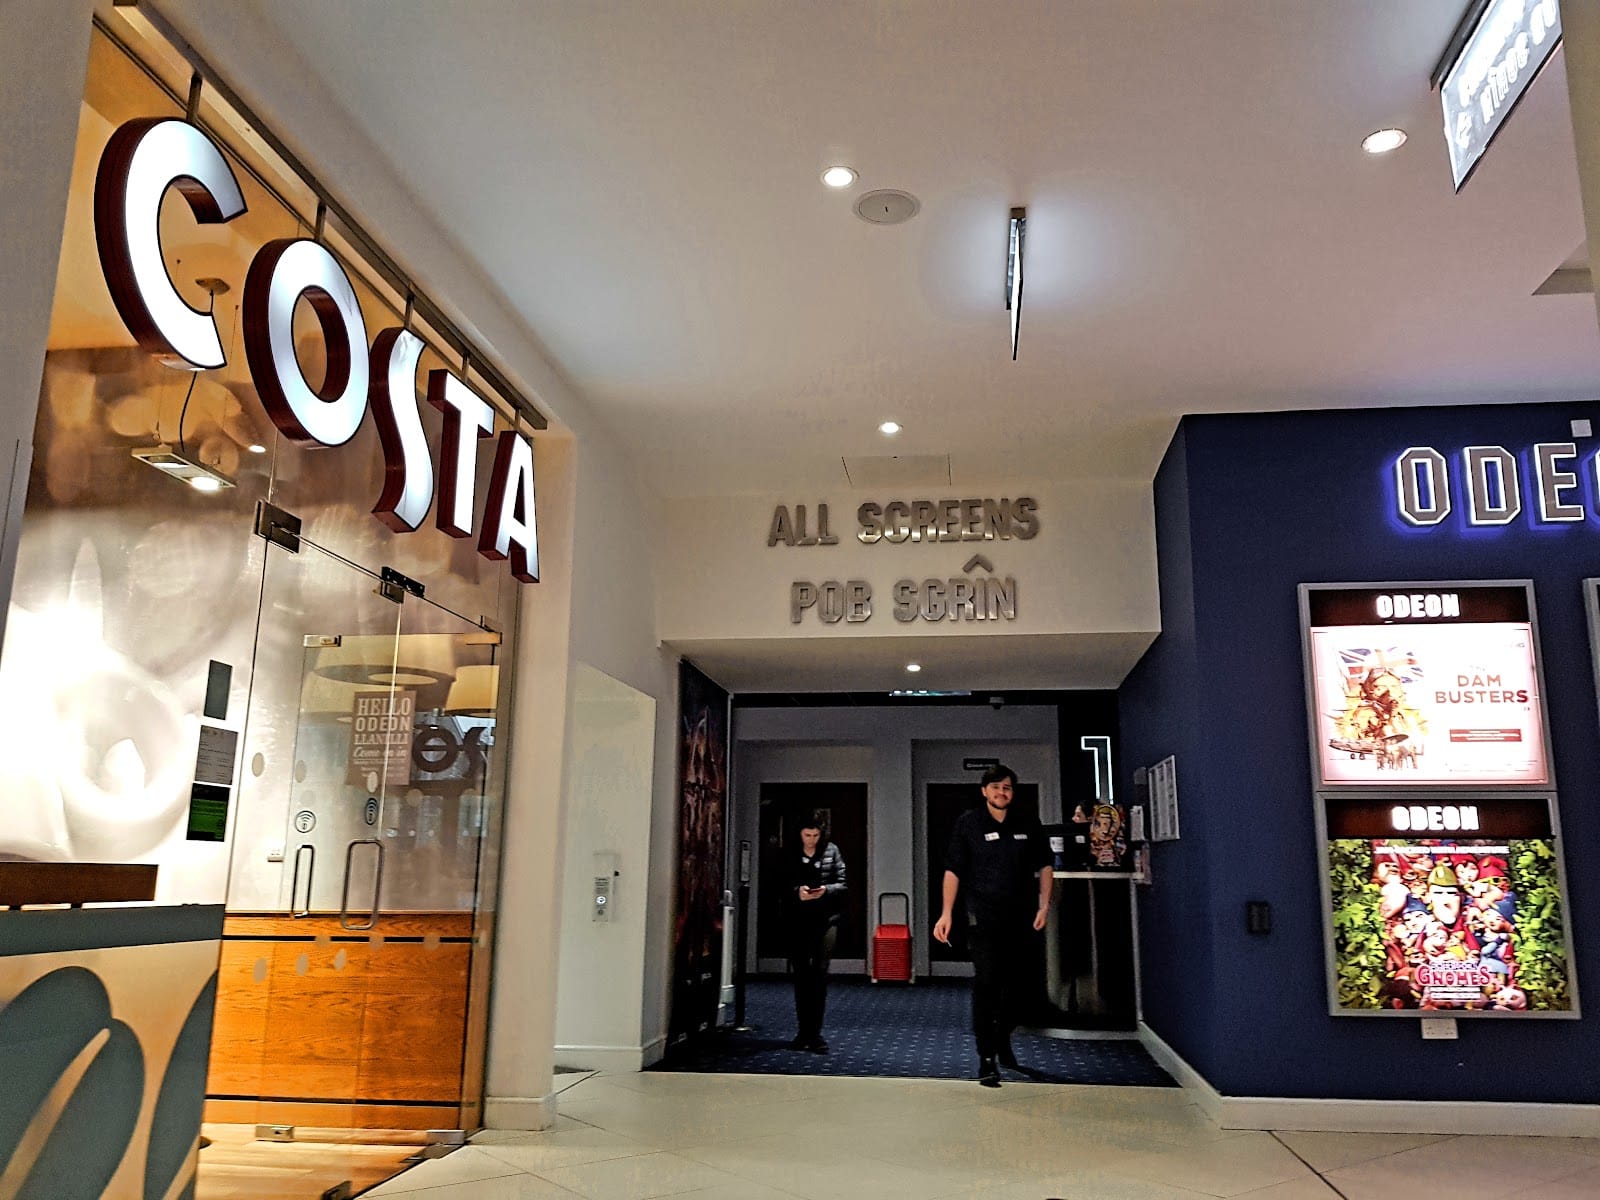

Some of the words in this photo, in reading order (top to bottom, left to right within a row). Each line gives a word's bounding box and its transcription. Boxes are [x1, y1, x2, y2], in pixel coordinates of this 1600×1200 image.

[94, 116, 540, 583] COSTA
[1396, 442, 1600, 525] ODE
[767, 503, 839, 547] ALL
[857, 497, 1041, 545] SCREENS
[790, 580, 872, 624] POB
[893, 553, 1017, 622] SGRÎN
[1375, 593, 1460, 619] ODEON
[1457, 674, 1501, 687] DAM
[357, 697, 411, 716] HELLO
[1435, 689, 1529, 704] BUSTERS
[355, 716, 411, 732] ODEON
[1081, 735, 1114, 805] 1
[1391, 805, 1480, 831] ODEON
[1415, 964, 1492, 987] GNOMES
